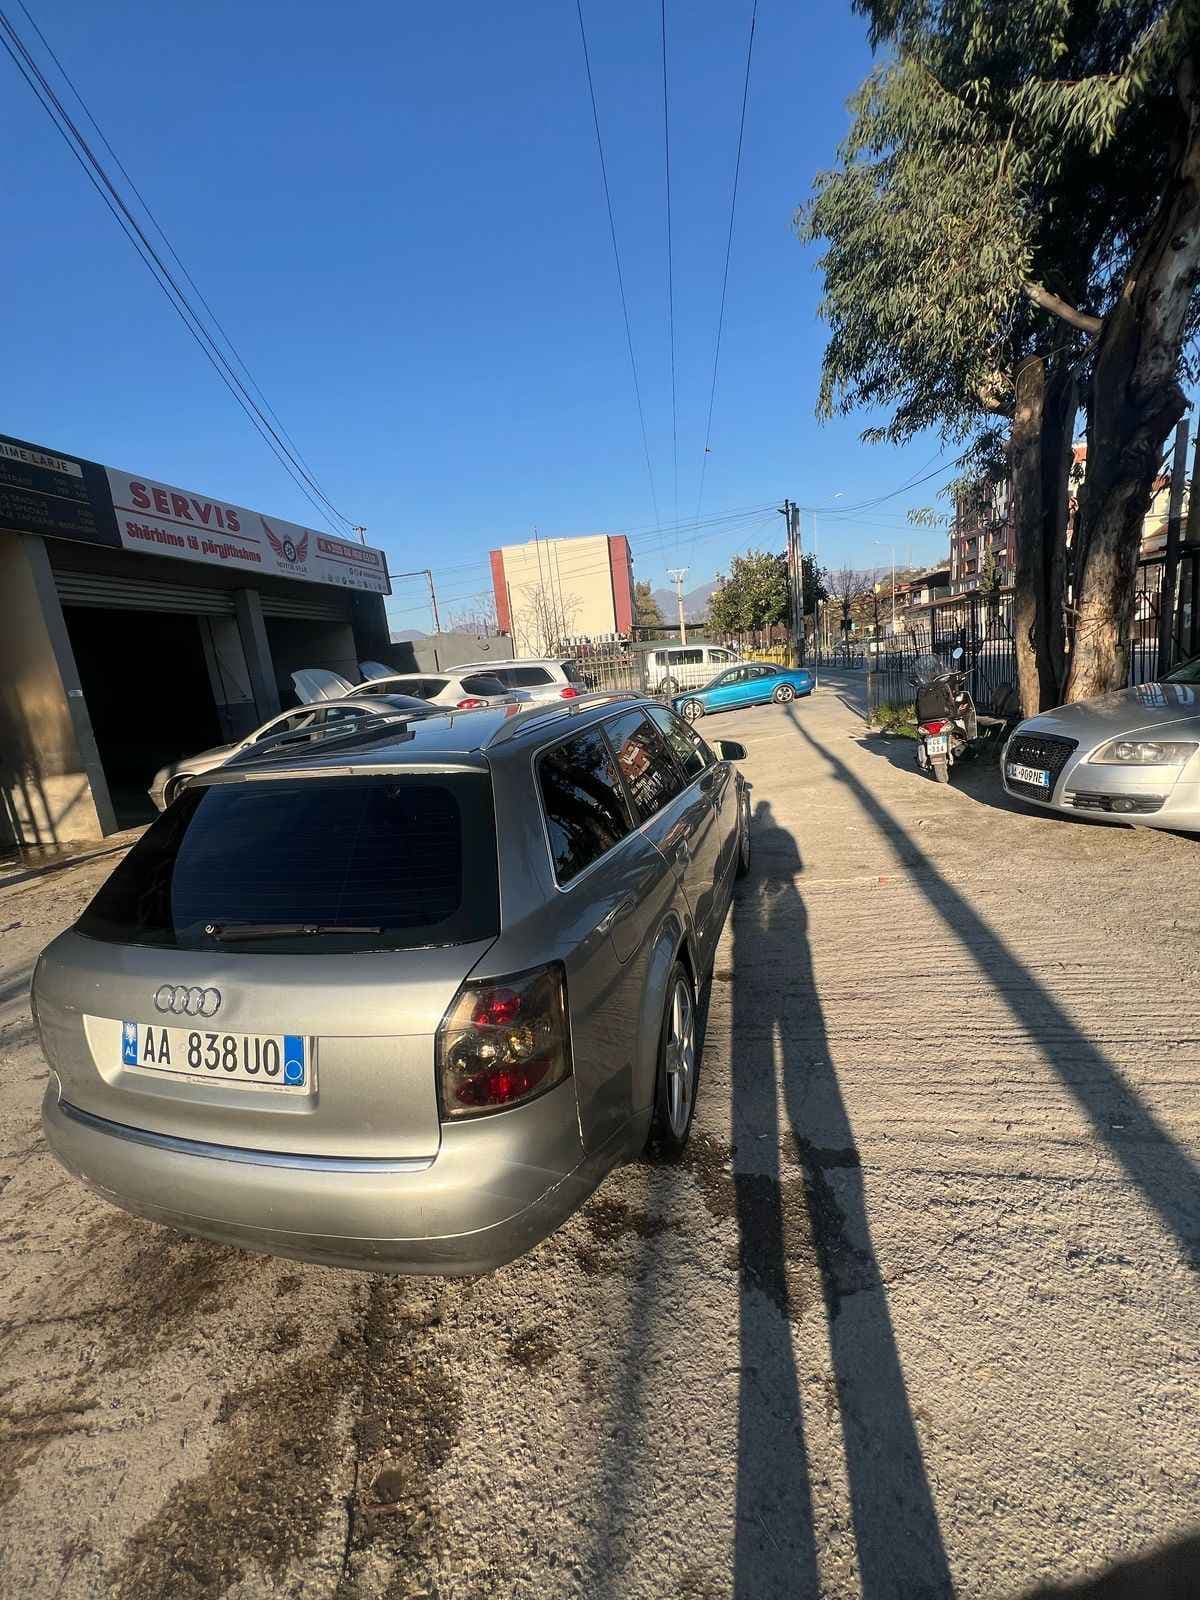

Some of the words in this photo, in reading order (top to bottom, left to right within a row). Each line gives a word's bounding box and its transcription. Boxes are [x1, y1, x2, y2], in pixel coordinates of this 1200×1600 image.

[31, 453, 69, 472] LARJE
[129, 481, 241, 532] SERVIS
[126, 521, 185, 548] Shërbime
[187, 534, 199, 550] të
[143, 1026, 171, 1064] AA
